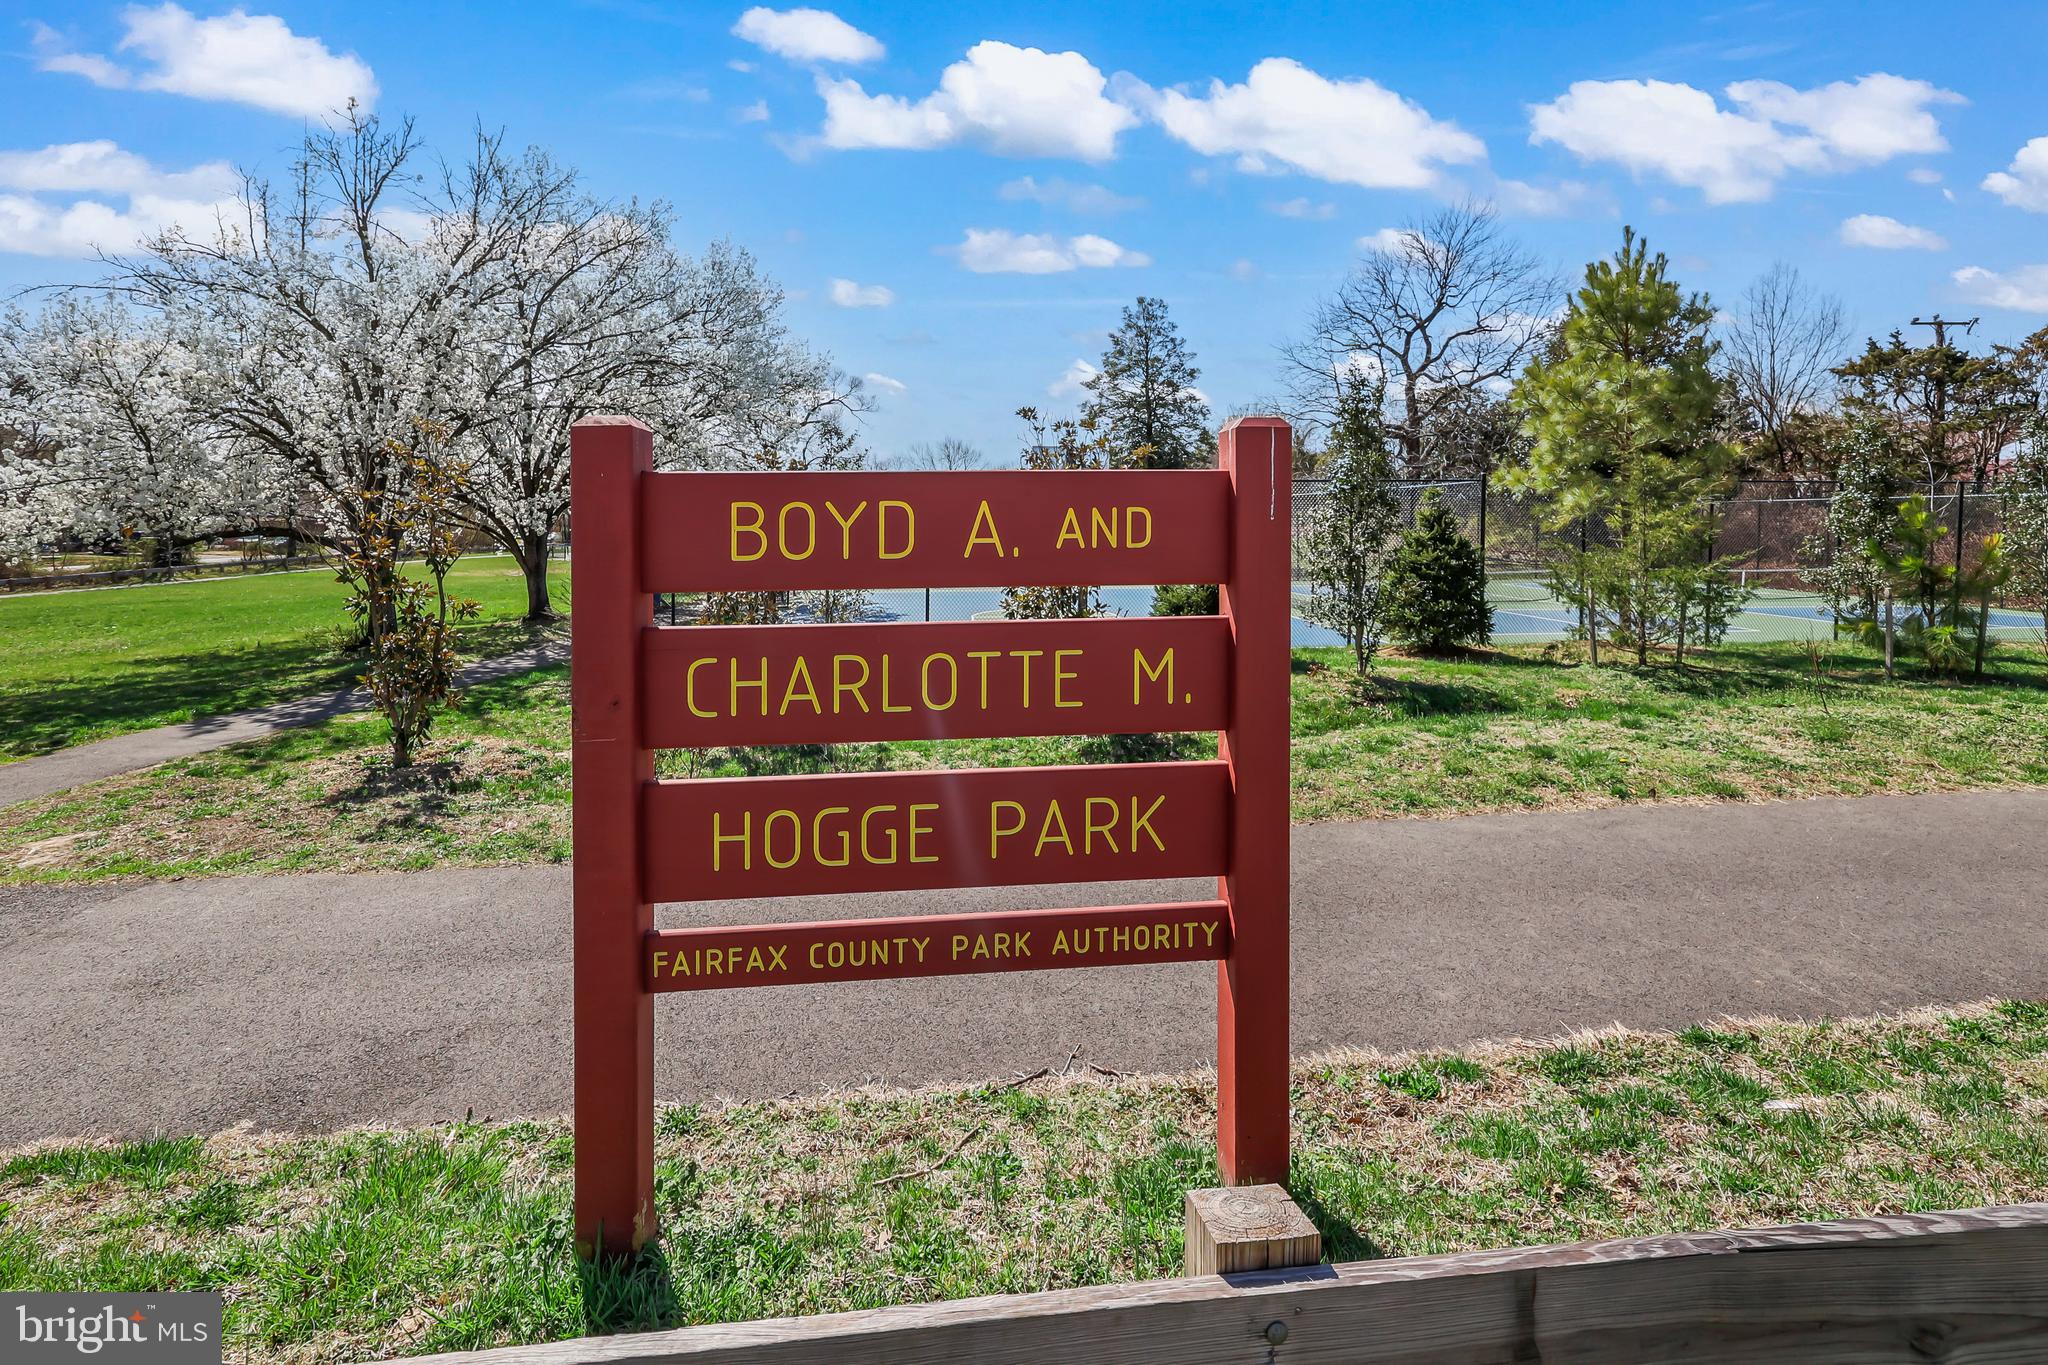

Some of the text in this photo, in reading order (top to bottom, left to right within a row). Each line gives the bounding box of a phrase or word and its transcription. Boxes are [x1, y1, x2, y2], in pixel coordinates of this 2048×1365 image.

[730, 499, 1152, 562] BOYD A. AND
[686, 647, 1192, 718] CHARLOTTE M.
[713, 794, 1166, 871] HOGGE PARK
[653, 922, 1217, 977] FAIRFAX COUNTY PARK AUTHORITY
